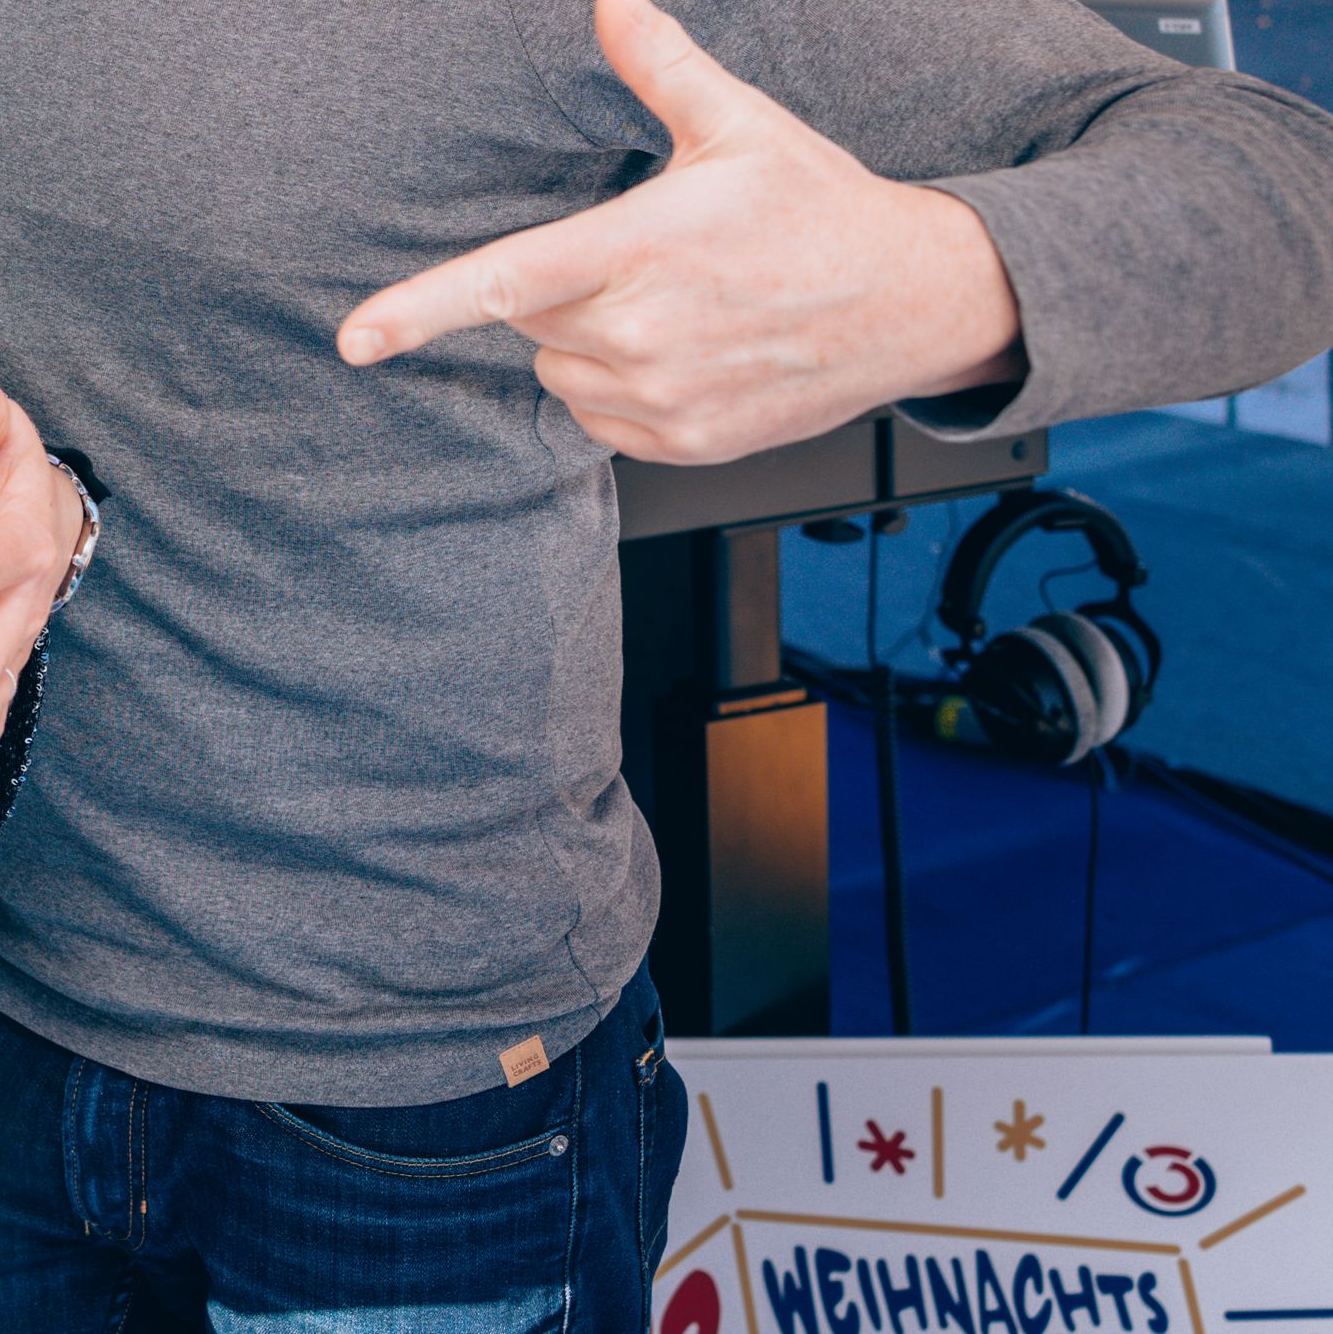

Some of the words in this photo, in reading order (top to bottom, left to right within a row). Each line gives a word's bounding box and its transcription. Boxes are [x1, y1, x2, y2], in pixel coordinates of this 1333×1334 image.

[510, 1053, 539, 1072] LIVING
[513, 1059, 542, 1077] CRAFTS
[761, 1245, 1170, 1334] WEIHNACHTS
